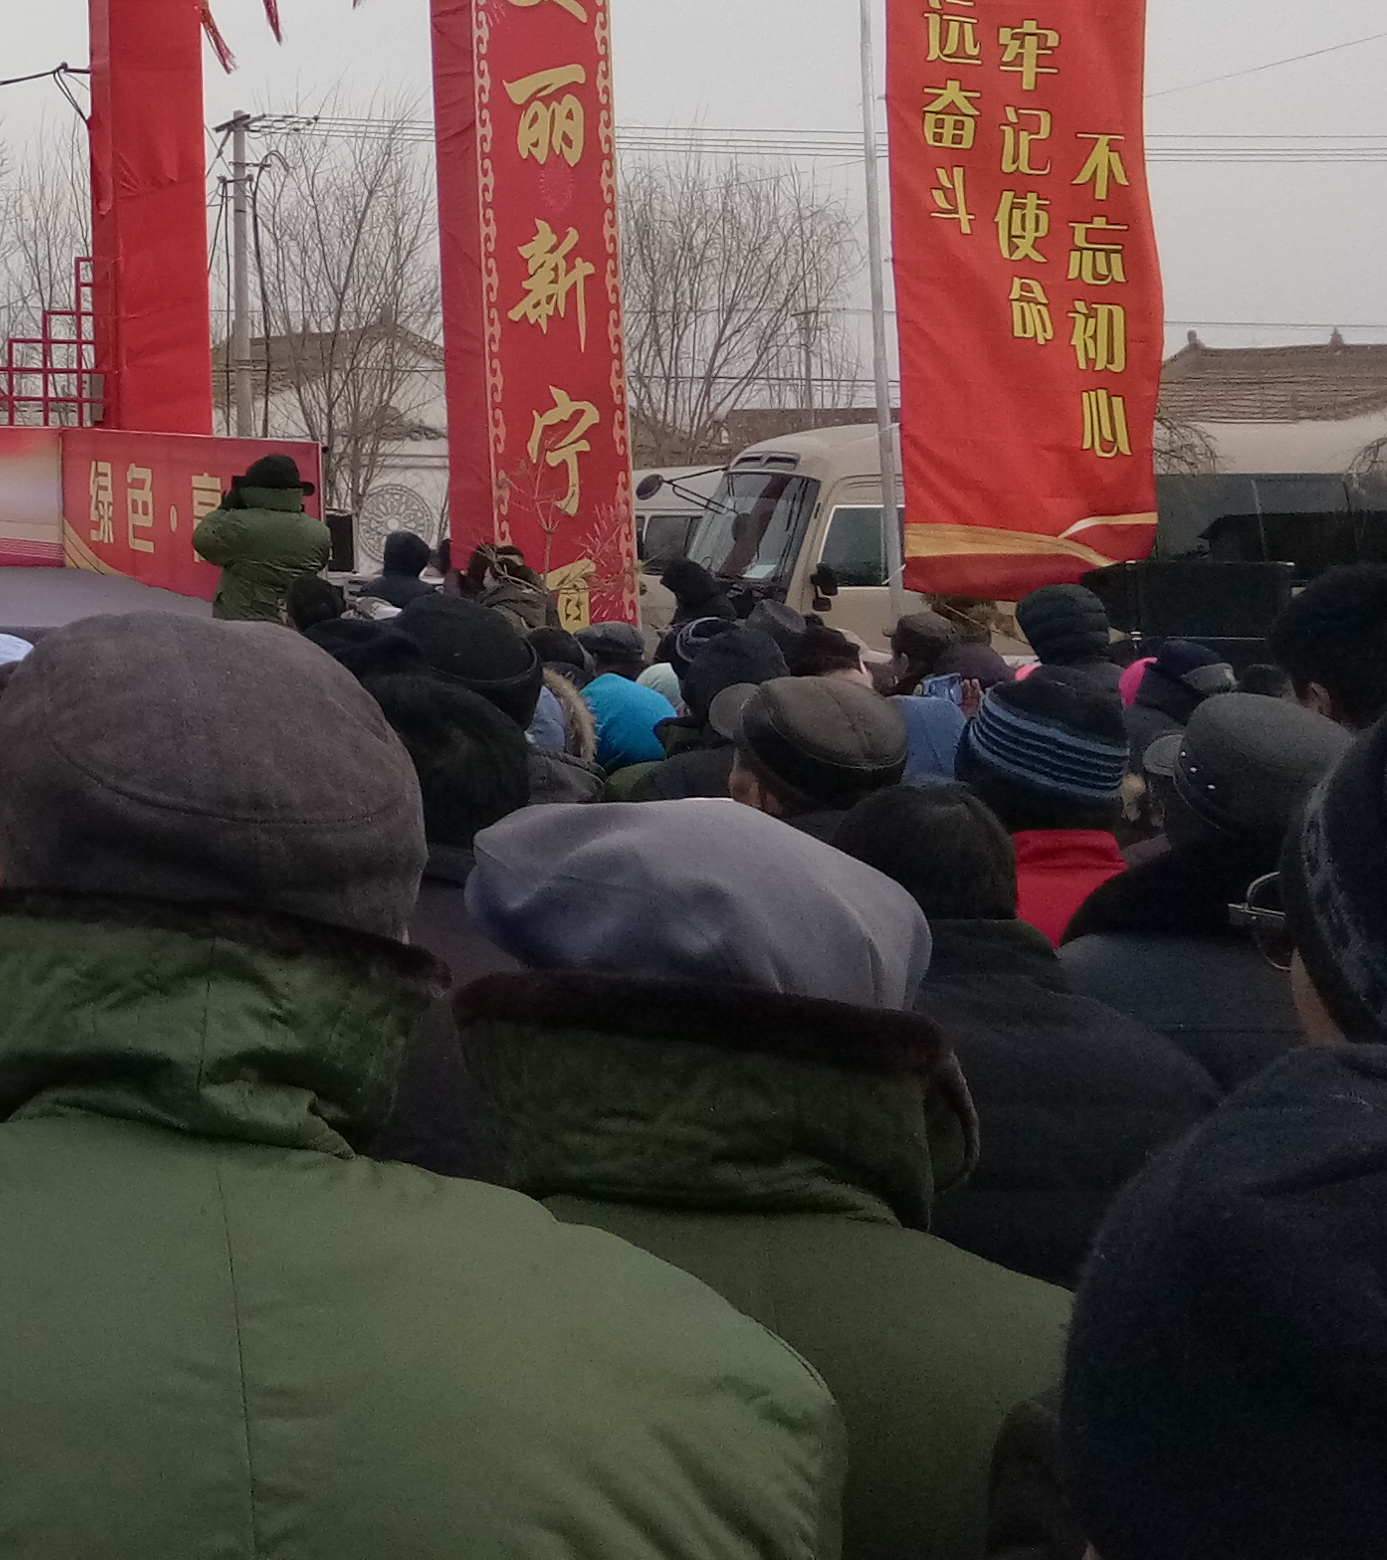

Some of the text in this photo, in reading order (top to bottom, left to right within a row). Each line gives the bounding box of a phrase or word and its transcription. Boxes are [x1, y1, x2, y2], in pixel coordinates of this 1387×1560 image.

[993, 19, 1061, 346] 牢记使命
[1066, 132, 1133, 459] 不忘初心
